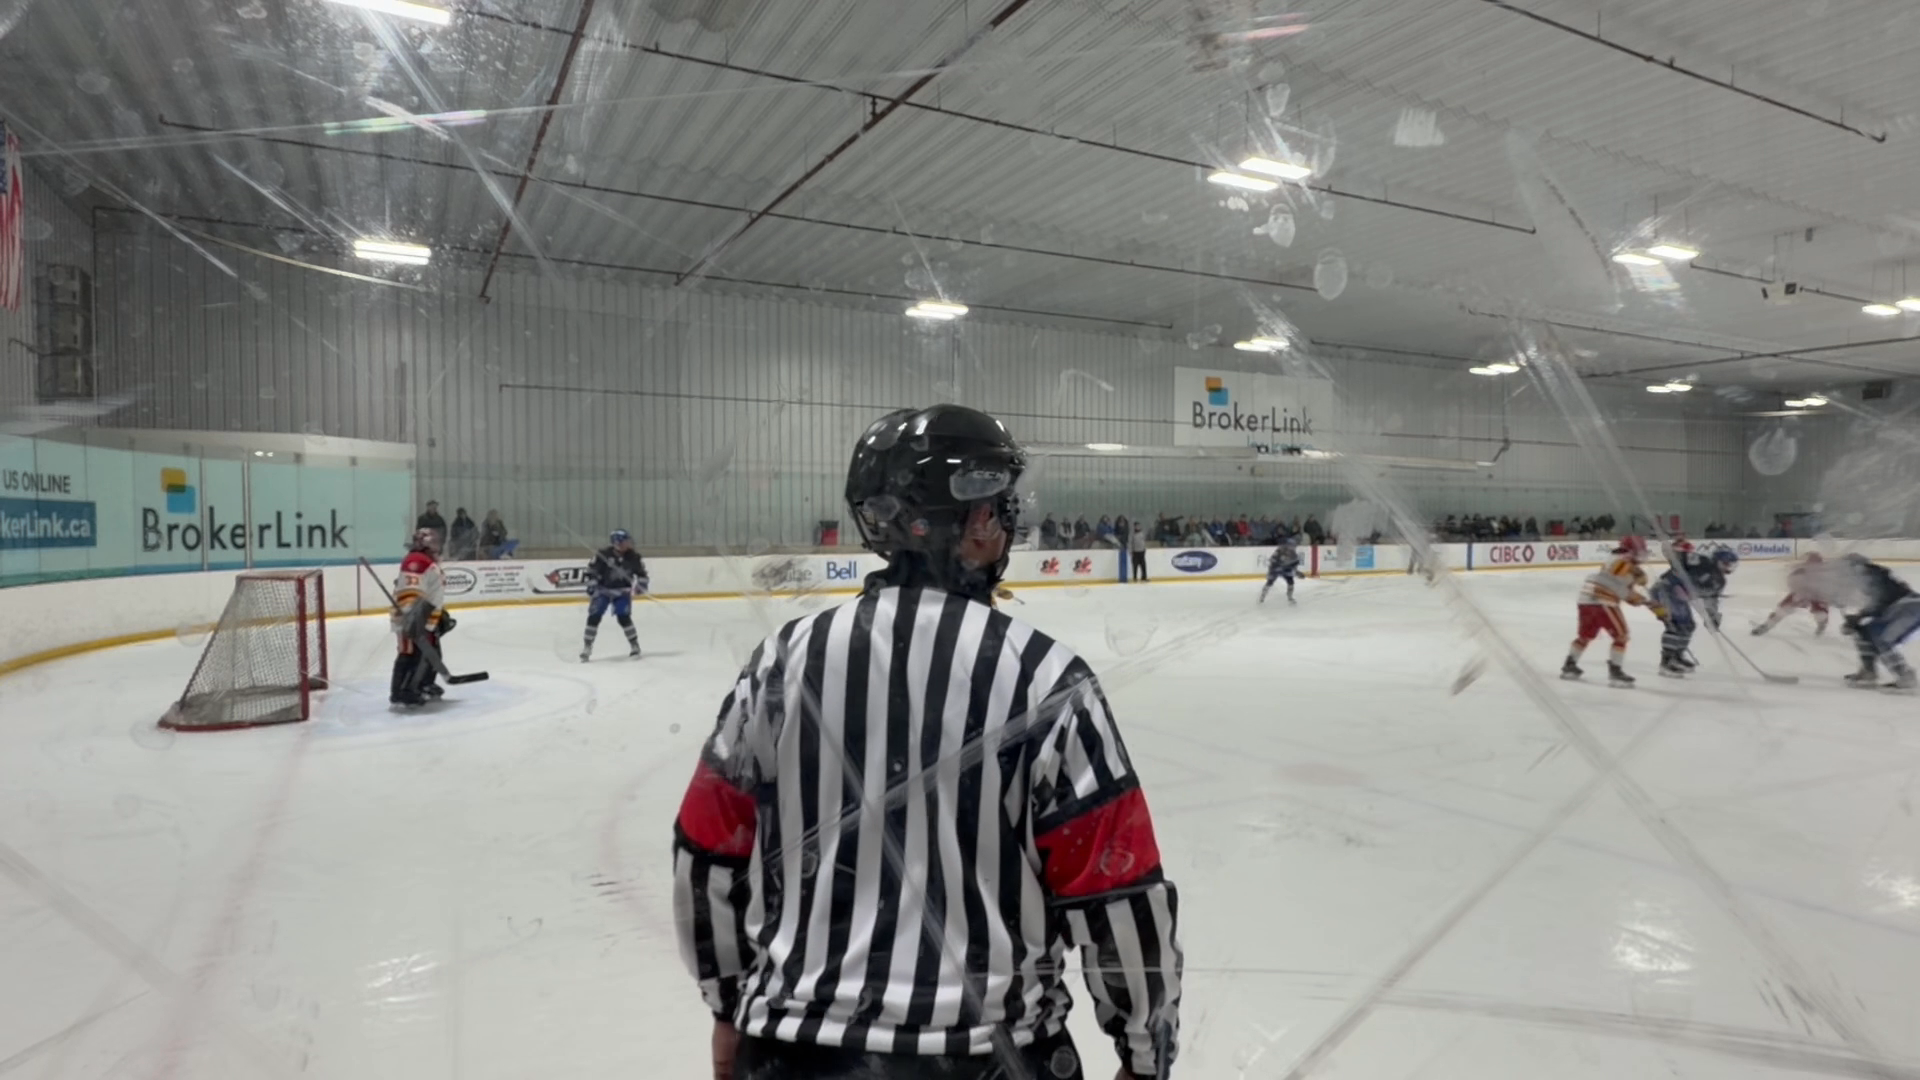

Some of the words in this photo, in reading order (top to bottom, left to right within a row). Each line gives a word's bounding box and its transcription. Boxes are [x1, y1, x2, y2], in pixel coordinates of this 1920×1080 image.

[1192, 400, 1312, 436] BrokerLink
[3, 469, 19, 490] US
[21, 471, 71, 494] ONLINE
[142, 506, 349, 552] BrokerLink
[1490, 546, 1521, 563] CIBC
[826, 560, 857, 579] Bell
